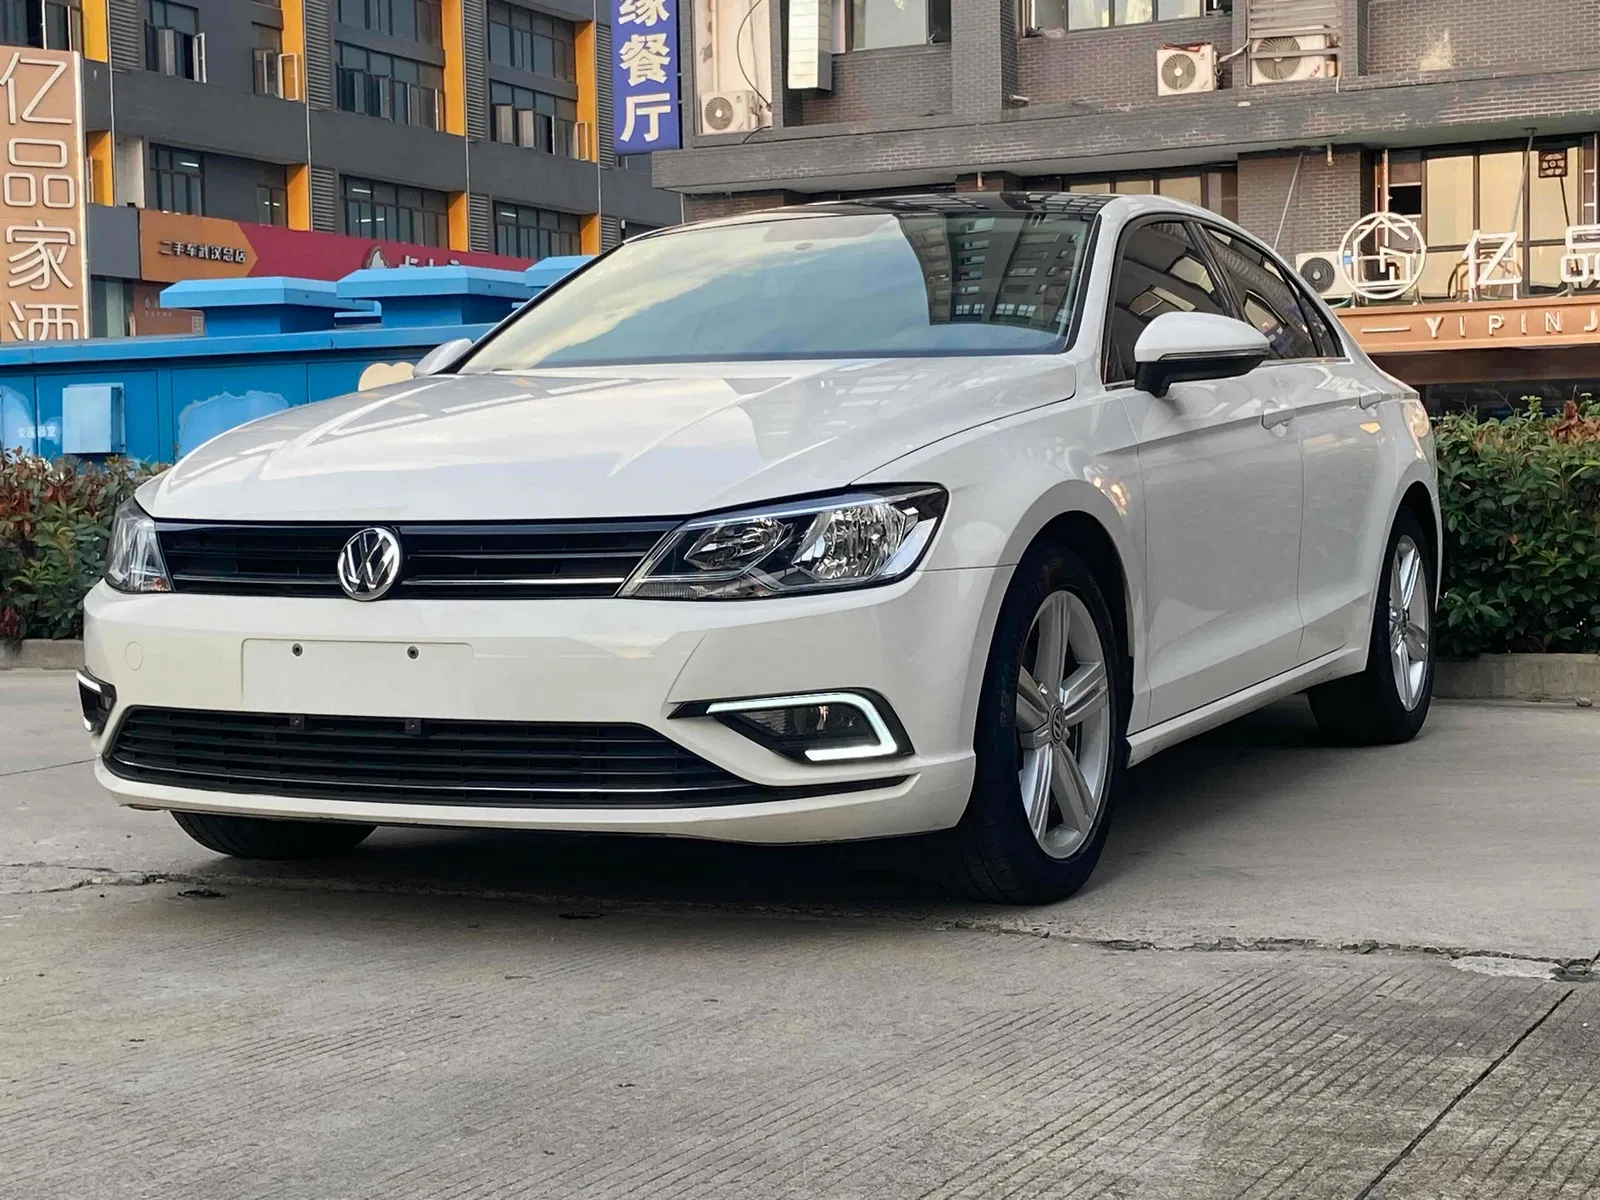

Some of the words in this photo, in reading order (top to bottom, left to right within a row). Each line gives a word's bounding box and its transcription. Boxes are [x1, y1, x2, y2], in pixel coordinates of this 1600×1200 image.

[158, 239, 247, 264] 二手车武汉总店
[337, 527, 401, 601] VW
